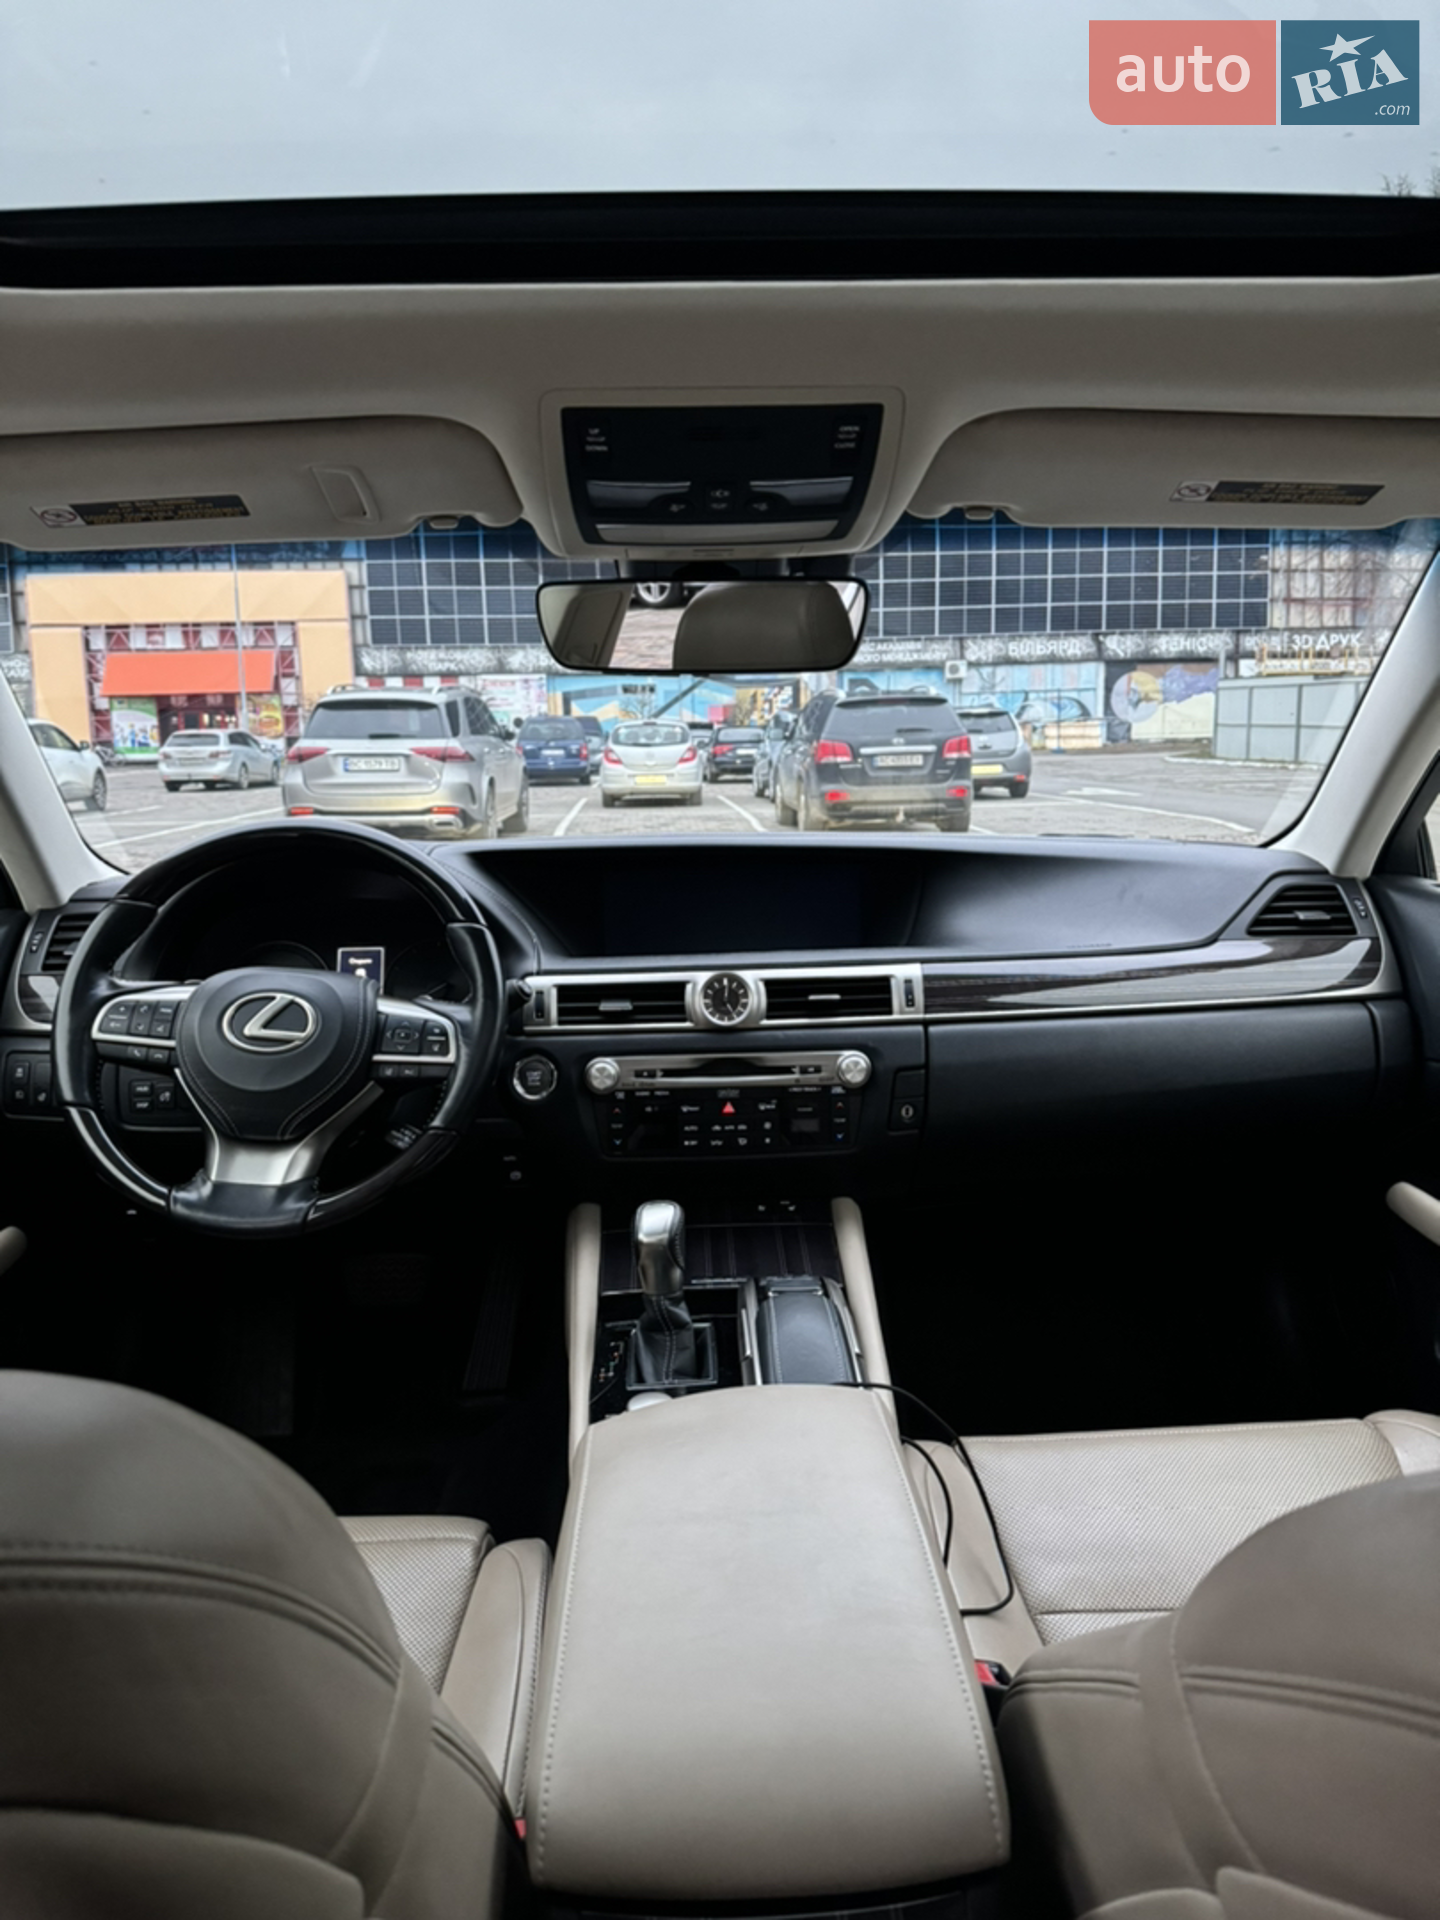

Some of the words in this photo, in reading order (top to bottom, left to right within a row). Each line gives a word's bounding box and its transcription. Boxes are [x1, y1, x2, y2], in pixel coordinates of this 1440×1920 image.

[1007, 640, 1081, 656] БІЛЬЯРД
[1292, 633, 1312, 650] 3D
[1315, 630, 1363, 651] ДРУК
